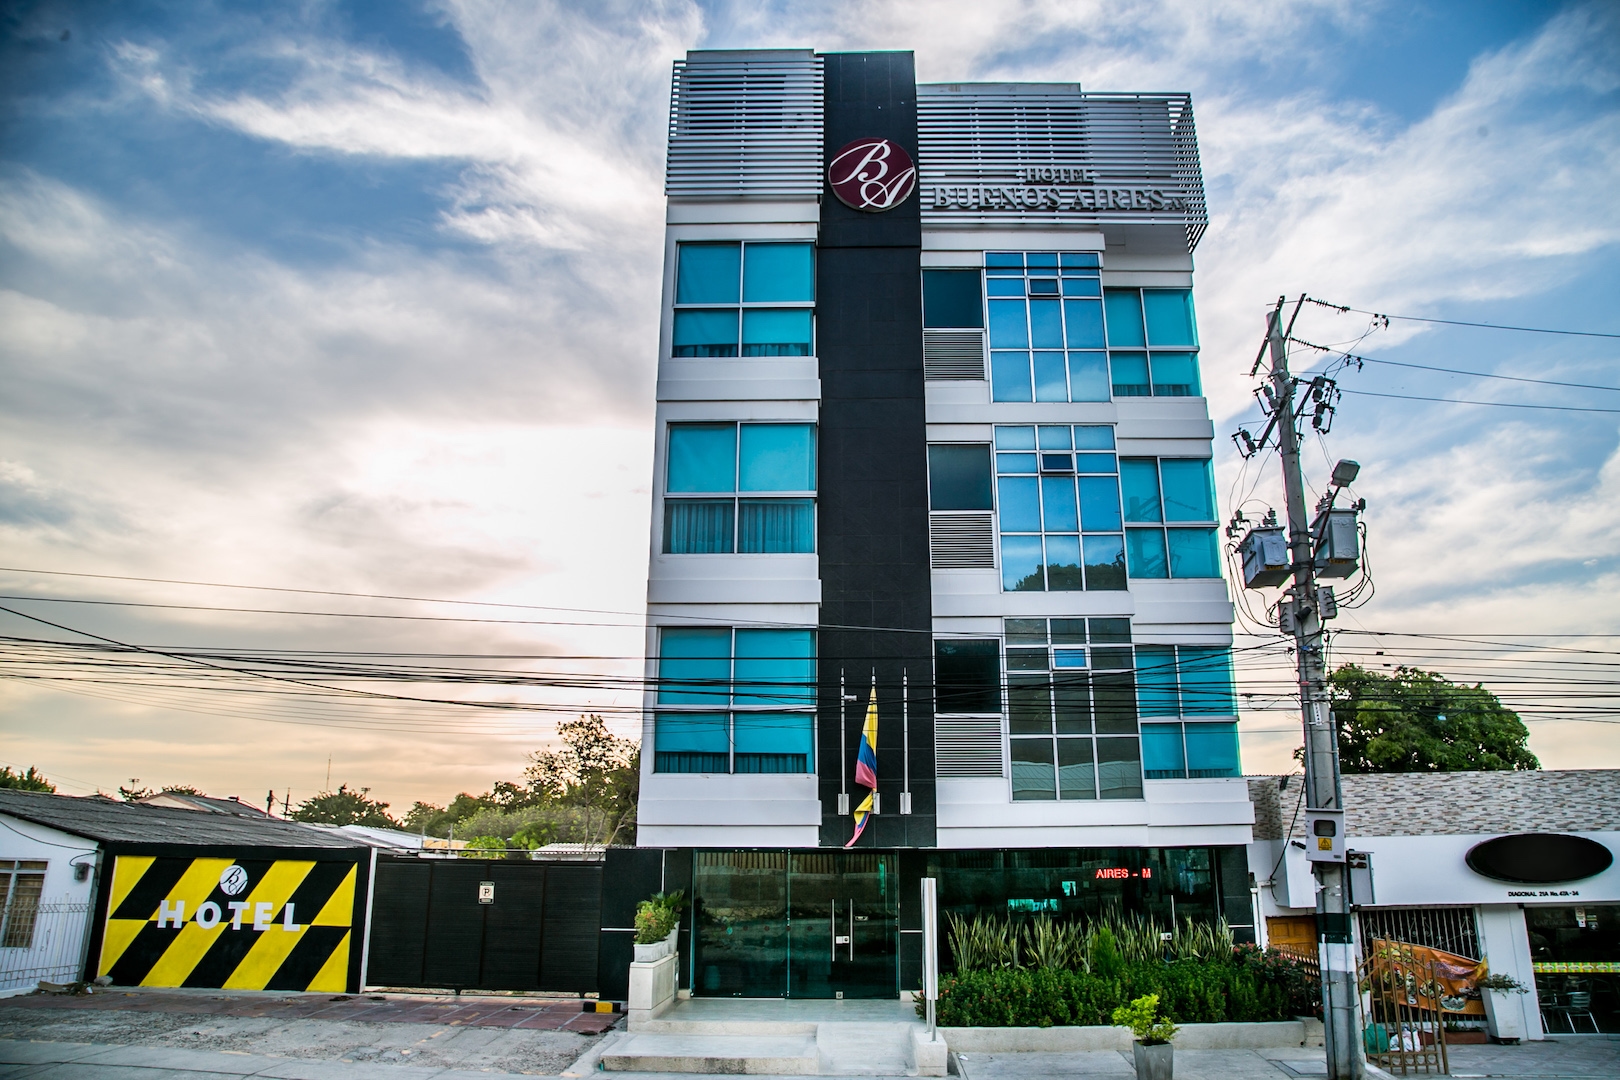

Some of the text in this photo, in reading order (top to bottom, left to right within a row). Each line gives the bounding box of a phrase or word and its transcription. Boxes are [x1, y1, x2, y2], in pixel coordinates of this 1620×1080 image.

[1025, 167, 1092, 183] HOTEL
[933, 187, 1060, 209] BUENOS
[1069, 188, 1165, 211] AIRES
[1095, 868, 1129, 879] AIRES
[1142, 868, 1152, 879] M
[157, 900, 301, 932] HOTEL
